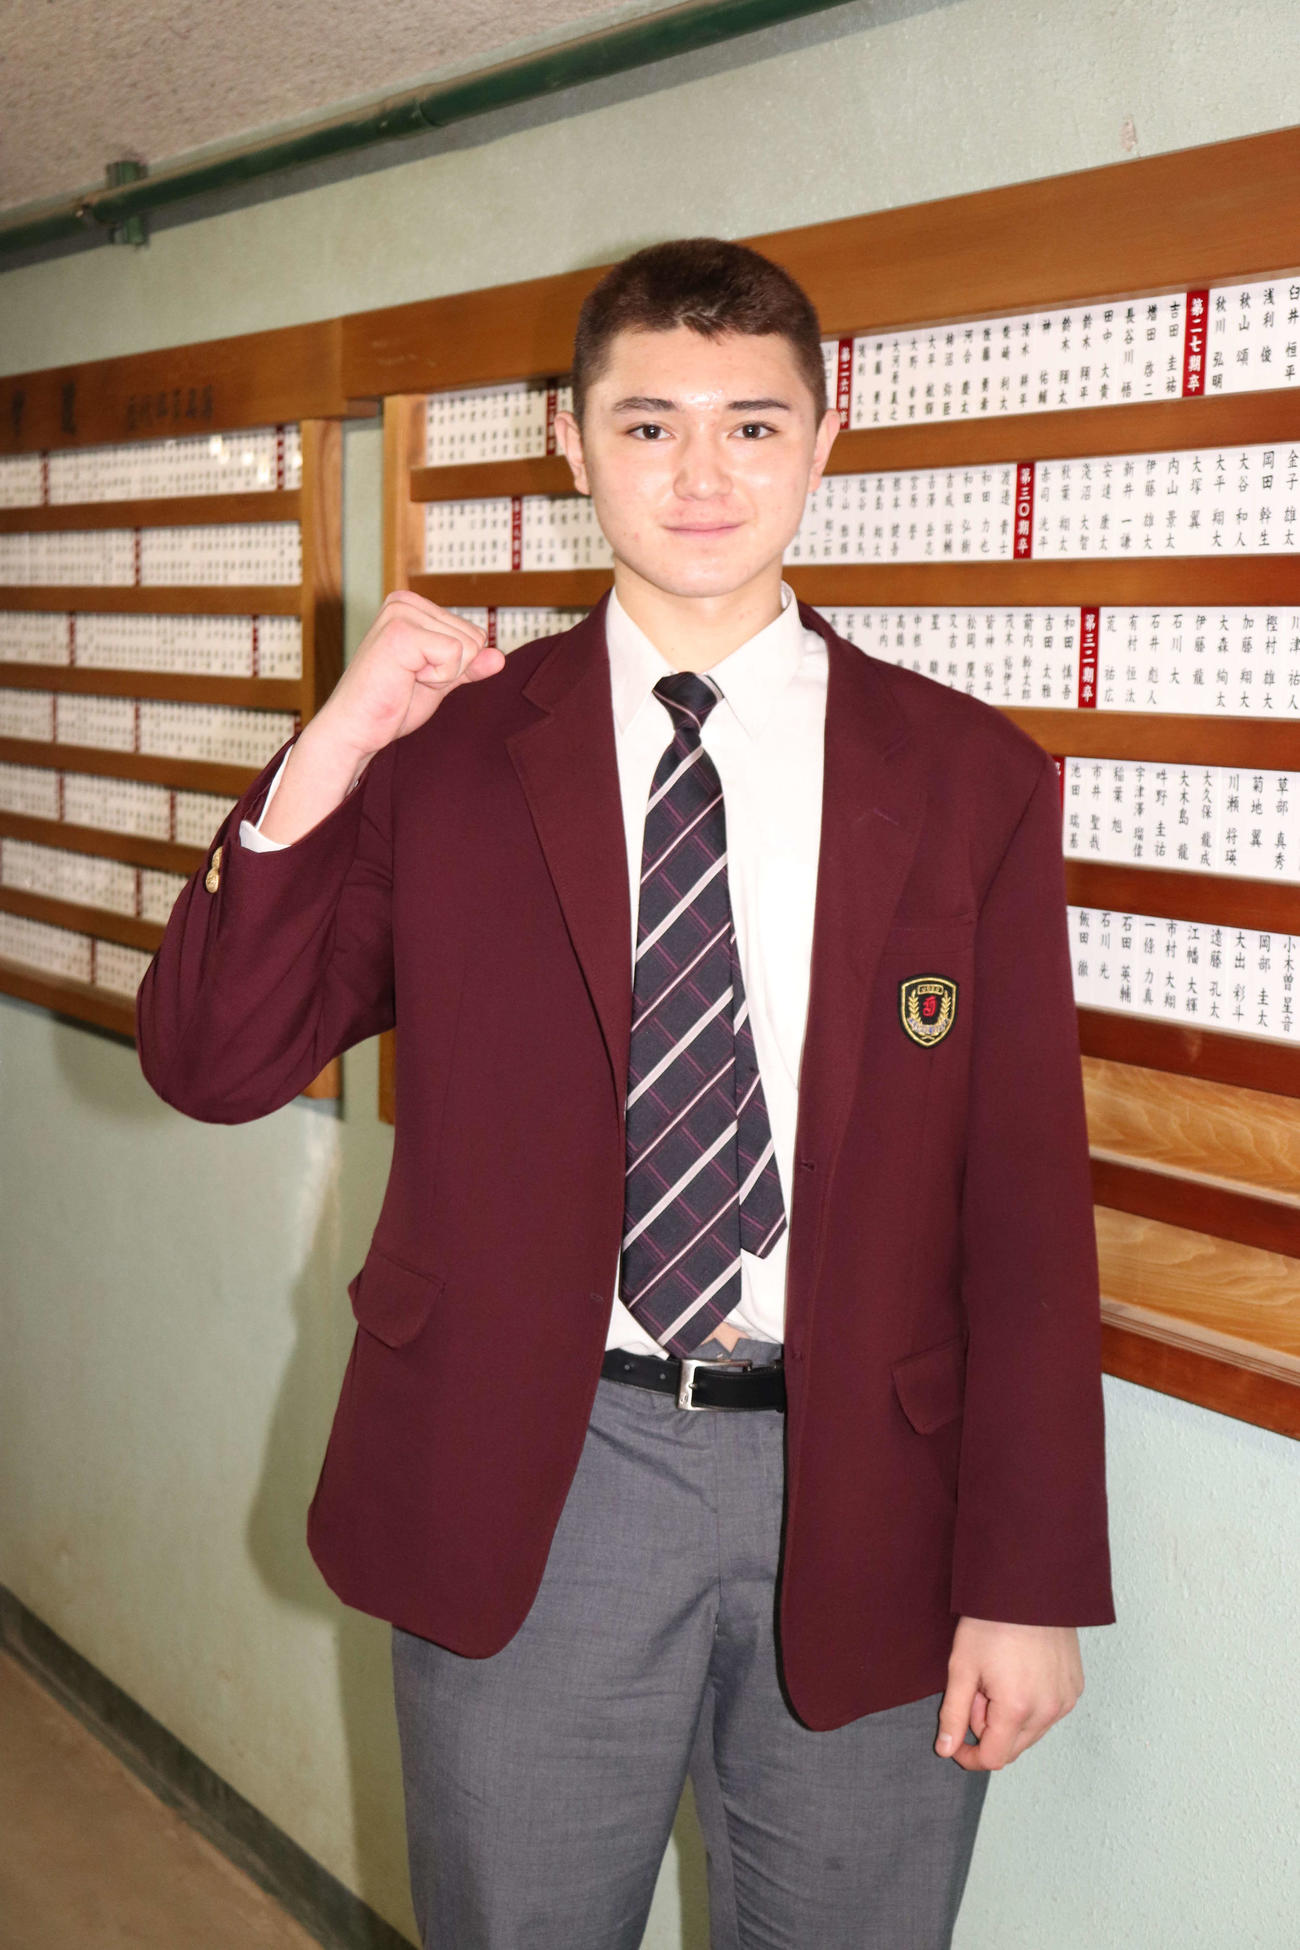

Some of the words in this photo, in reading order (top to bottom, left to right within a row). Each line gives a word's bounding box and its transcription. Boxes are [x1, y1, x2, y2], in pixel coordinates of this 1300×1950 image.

[1103, 310, 1114, 340] 田中
[1169, 301, 1181, 337] 吉田
[1216, 296, 1226, 332] 秋川
[1239, 292, 1251, 331] 秋山
[1124, 307, 1135, 362] 長谷川
[1187, 297, 1204, 392] 第二七期卒
[1212, 352, 1224, 389] 弘明
[1285, 342, 1296, 380] 恒平
[982, 470, 992, 502] 和田
[1123, 461, 1134, 497] 新井
[1145, 459, 1158, 497] 伊藤
[1167, 457, 1179, 495] 内山
[1214, 454, 1226, 491] 大平
[1238, 452, 1250, 492] 大谷
[1262, 450, 1275, 489] 岡田
[1286, 449, 1299, 490] 金子
[1189, 510, 1200, 528] 翼
[1212, 508, 1224, 547] 翔大
[1235, 507, 1248, 547] 和人
[1284, 506, 1296, 545] 雄太
[1044, 614, 1054, 648] 吉田
[1064, 614, 1075, 649] 和田
[1128, 614, 1139, 651] 有村
[1149, 614, 1160, 651] 石井
[1172, 613, 1184, 653] 石川
[1194, 614, 1207, 653] 伊藤
[1217, 614, 1229, 653] 大森
[1242, 614, 1254, 653] 加藤
[1171, 667, 1180, 684] 大
[1240, 668, 1252, 708] 翔大
[1264, 670, 1275, 709] 雄大
[1071, 763, 1081, 796] 池田
[1091, 764, 1103, 799] 市井
[1113, 766, 1124, 803] 稲葉
[1179, 770, 1189, 825] 大木島
[1202, 770, 1213, 819] 大久保
[1251, 776, 1264, 815] 菊地
[1276, 776, 1288, 816] 草部
[1250, 829, 1262, 848] 翼
[1275, 831, 1286, 870] 真秀
[1079, 910, 1089, 944] 飯田
[1101, 912, 1111, 949] 石川
[1122, 916, 1133, 950] 石田
[1166, 920, 1176, 958] 市村
[1210, 928, 1222, 969] 遠藤
[1235, 931, 1246, 969] 大出
[1258, 935, 1271, 972] 岡部
[1099, 962, 1110, 980] 光
[1209, 981, 1222, 1019] 孔太
[1232, 984, 1245, 1022] 彩斗
[1257, 988, 1269, 1027] 圭太
[1281, 996, 1293, 1032] 星音
